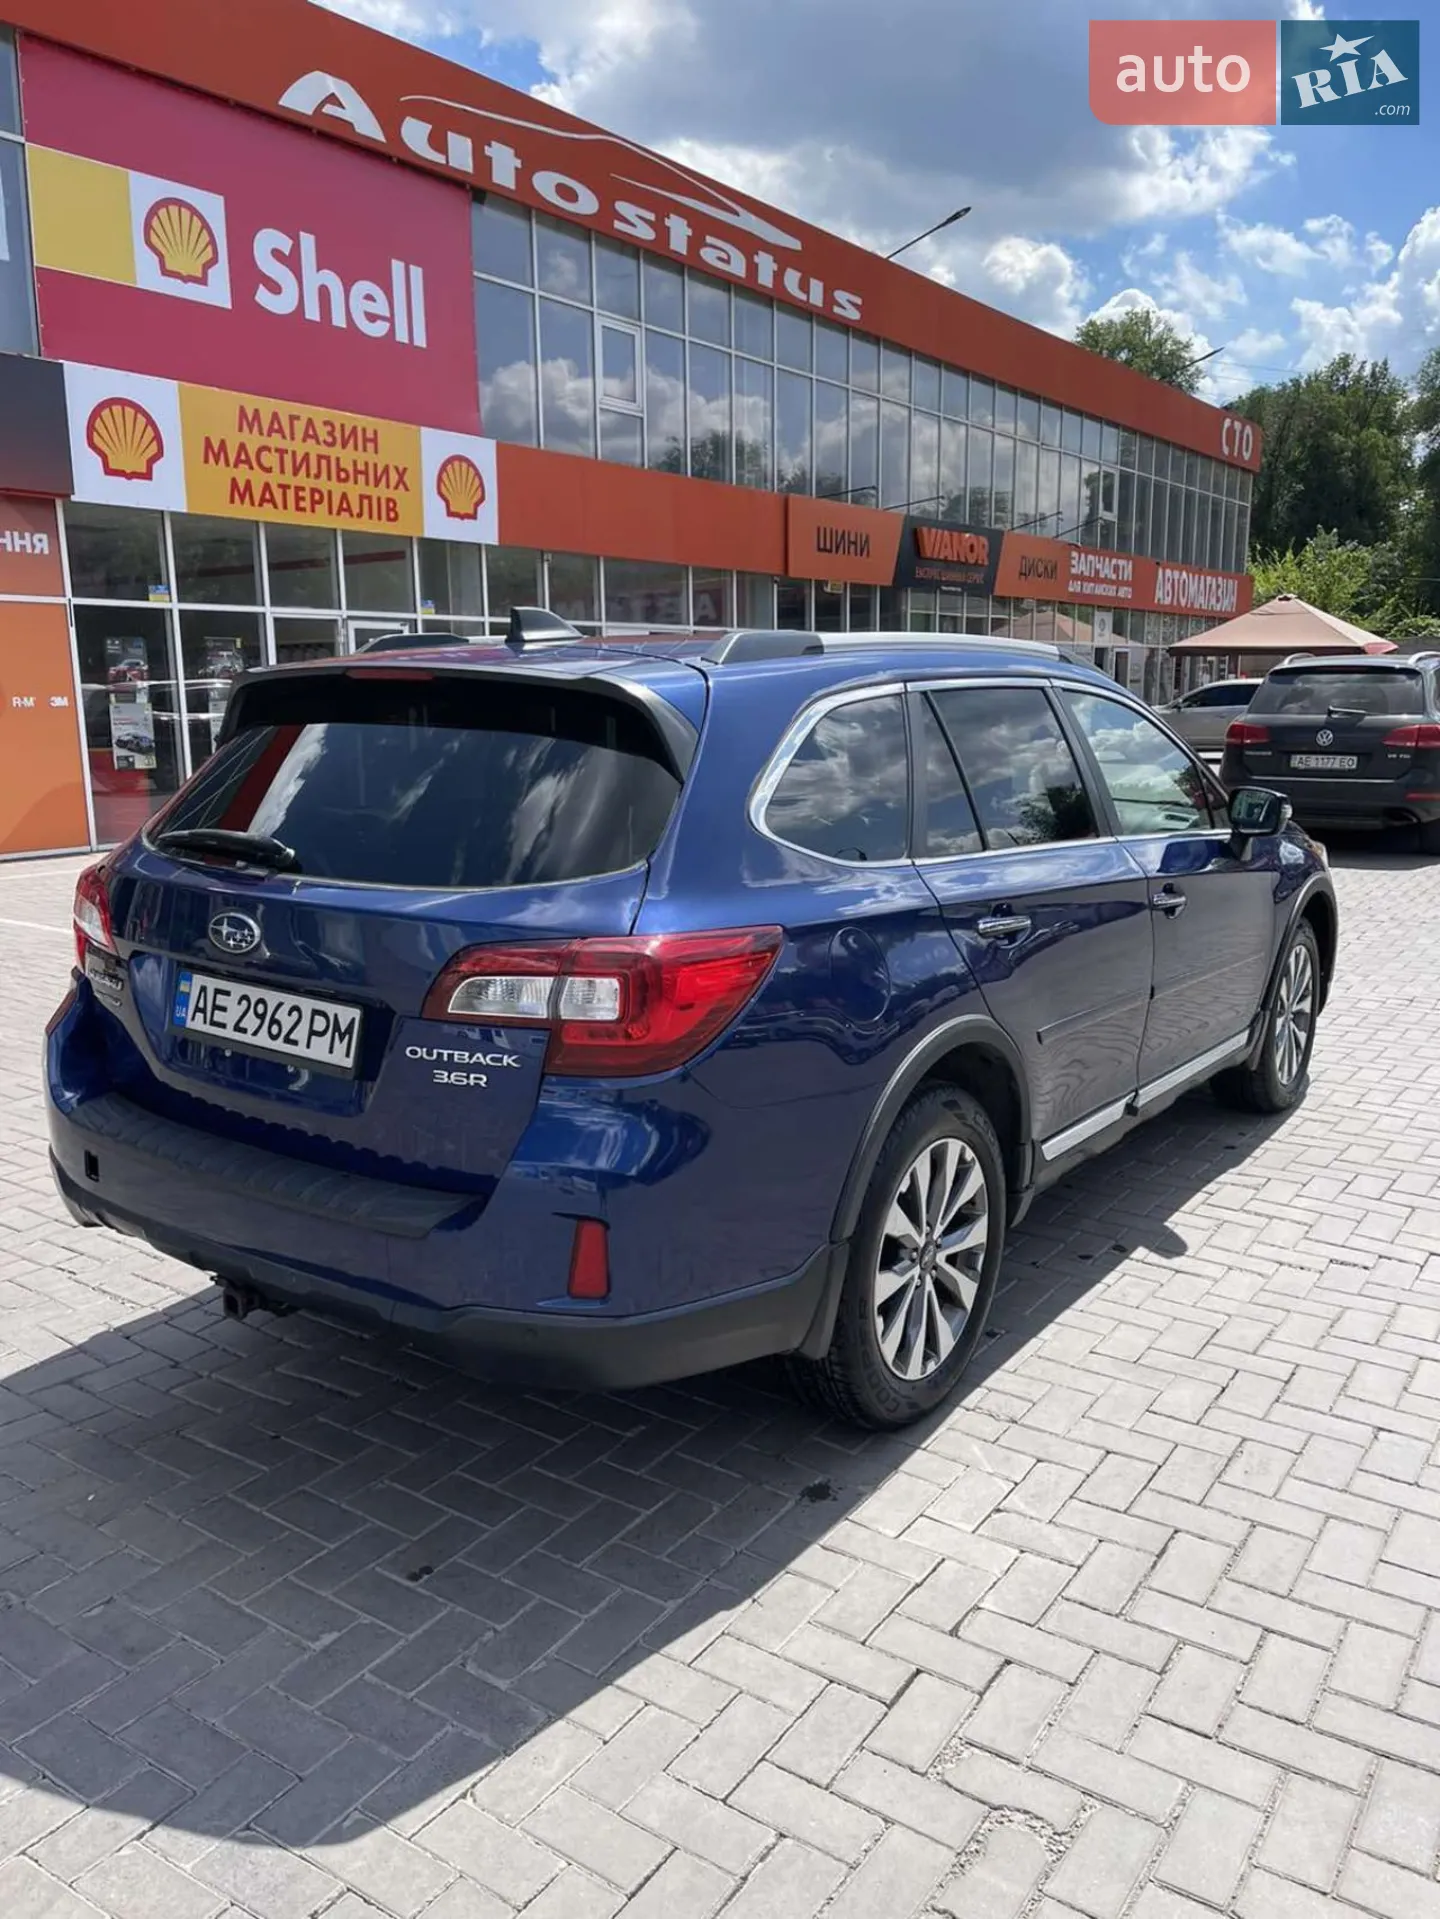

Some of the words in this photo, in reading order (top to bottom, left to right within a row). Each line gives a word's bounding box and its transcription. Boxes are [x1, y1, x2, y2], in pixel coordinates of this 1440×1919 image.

[253, 228, 427, 348] Shell
[237, 405, 379, 454] МАГАЗИН
[1222, 418, 1253, 461] СТО
[203, 436, 411, 492] МАСТИЛЬНИХ
[229, 477, 400, 523] МАТЕРІАЛІВ
[816, 526, 870, 558] ШИНИ
[916, 526, 989, 567] VIANOR
[1018, 555, 1058, 581] ДИСКИ
[1070, 550, 1132, 581] ЗАПЧАСТИ
[1154, 566, 1238, 612] АВТОМАГАЗИН
[50, 696, 69, 707] 3M
[1297, 757, 1311, 767] AE
[1314, 757, 1336, 768] 1177
[174, 1005, 187, 1018] UA
[191, 984, 232, 1030] AE
[233, 994, 303, 1046] 2962
[306, 1008, 356, 1058] PM
[405, 1046, 521, 1068] OUTBACK
[433, 1069, 488, 1088] 3.6R
